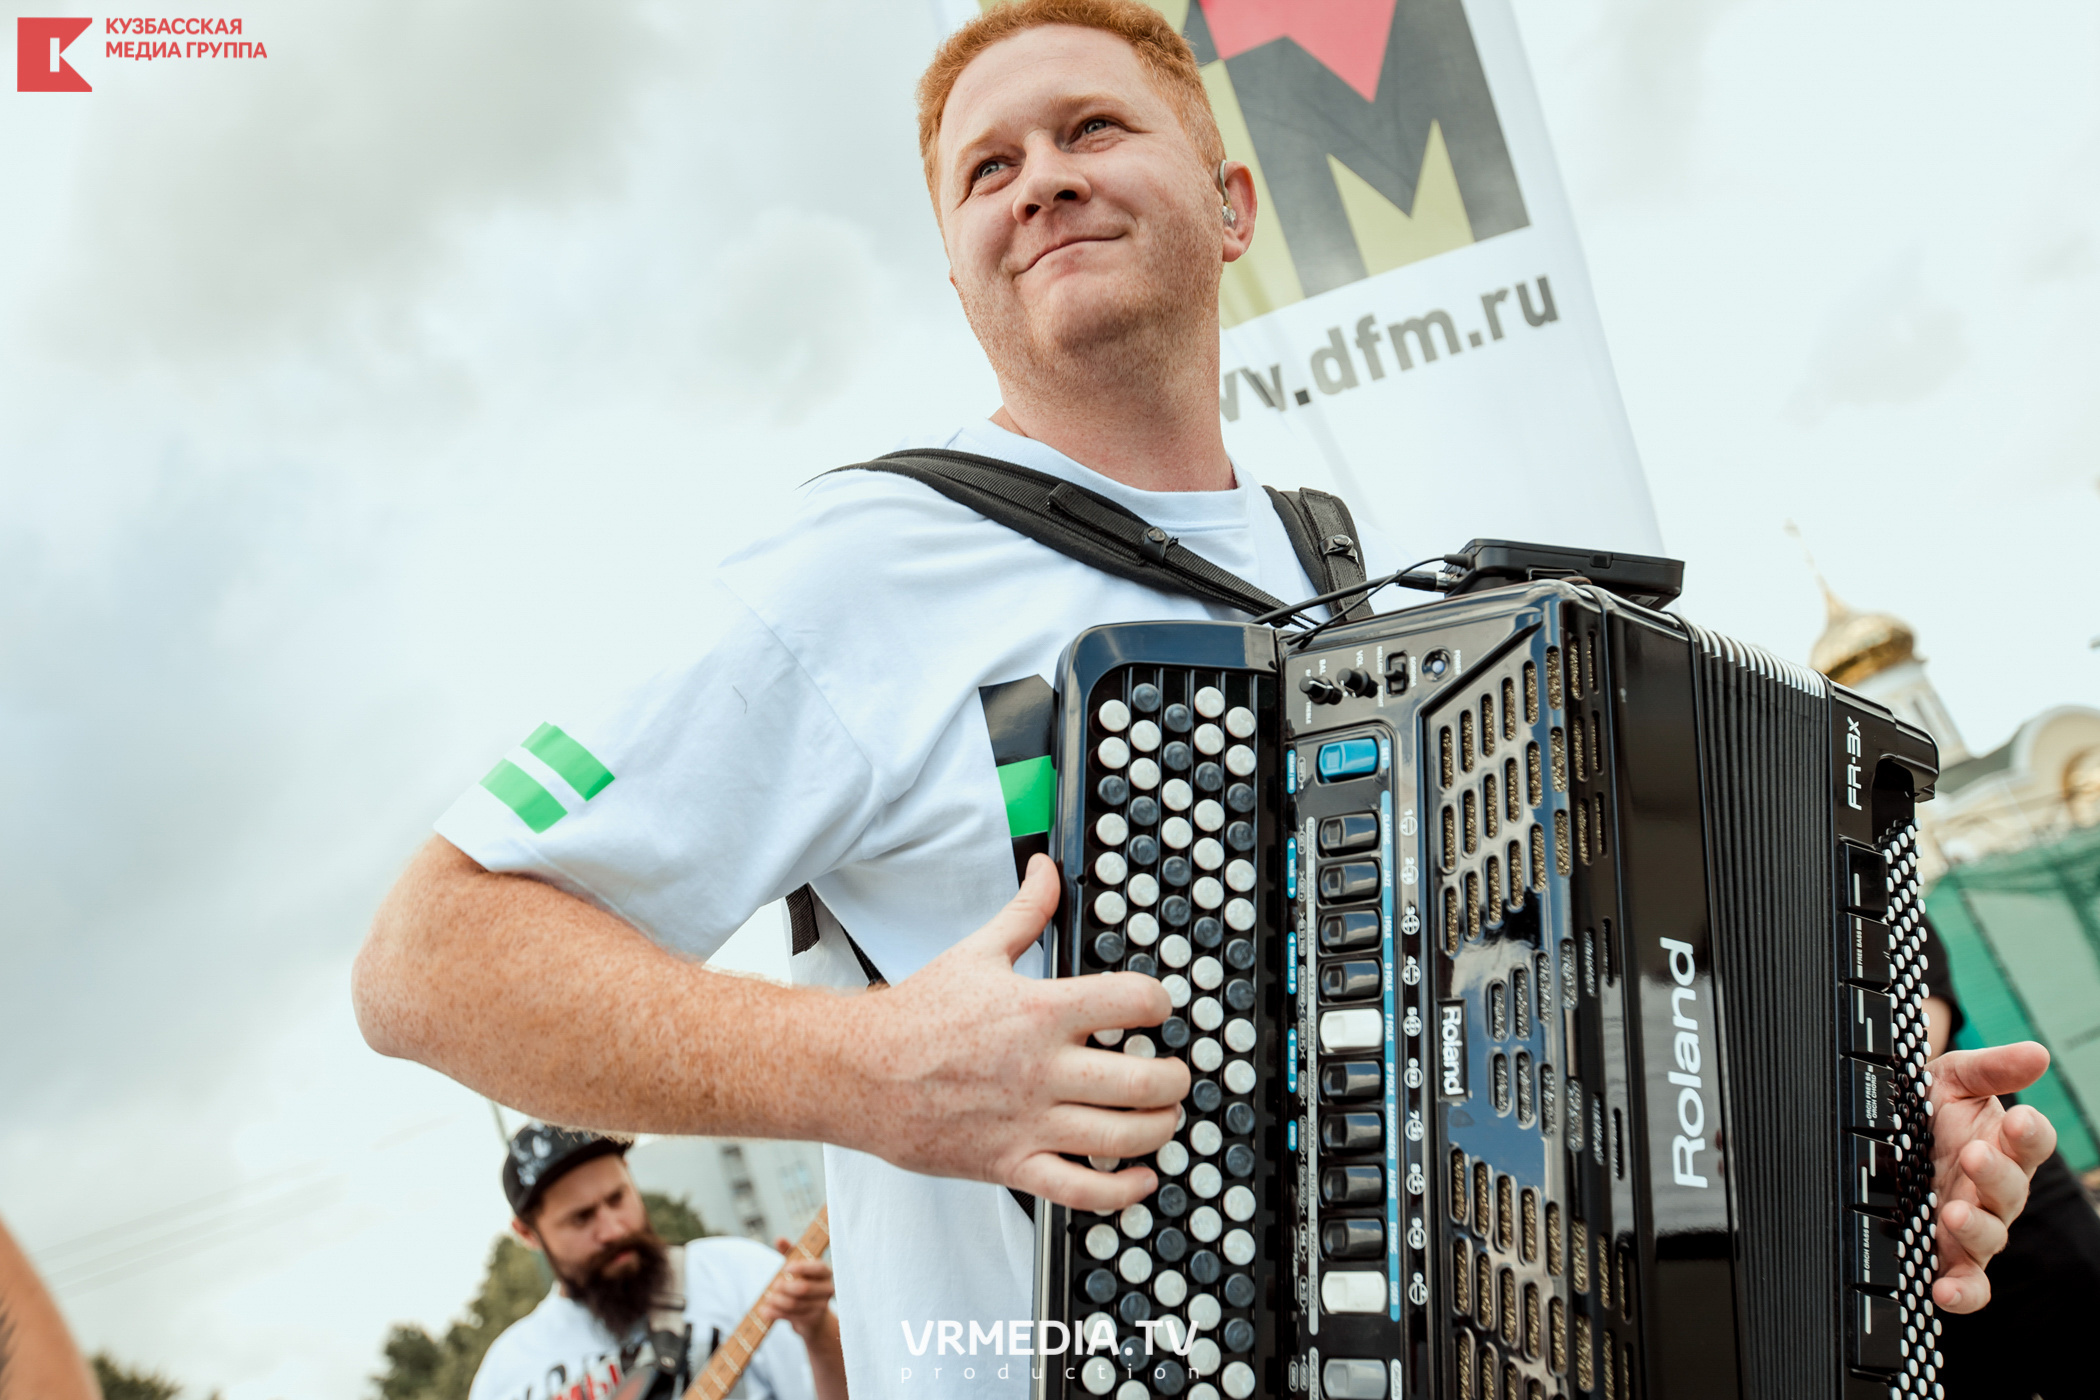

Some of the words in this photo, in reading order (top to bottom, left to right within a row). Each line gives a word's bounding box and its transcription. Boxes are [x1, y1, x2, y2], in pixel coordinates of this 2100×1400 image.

[1319, 658, 1327, 676] BAL
[1355, 649, 1364, 668] VOL
[1381, 746, 1389, 761] SET
[1403, 808, 1414, 816] 1
[1383, 813, 1391, 846] CLASSIC
[1404, 857, 1415, 865] 2
[1405, 906, 1416, 915] 3
[1406, 955, 1417, 965] 4
[1385, 971, 1393, 992] FOLK
[1407, 1006, 1418, 1016] 5
[1386, 1020, 1394, 1042] FOLK
[1442, 1006, 1465, 1096] Roland
[1408, 1058, 1419, 1068] 6
[1659, 936, 1708, 1188] Roland
[1386, 1074, 1394, 1096] FOLK
[1409, 1110, 1420, 1120] 7
[1387, 1102, 1396, 1160] BANDONEON
[1410, 1163, 1421, 1174] 8
[1388, 1168, 1397, 1200] ALPINE
[1411, 1217, 1422, 1228] 9
[1389, 1221, 1398, 1256] ETHNIC
[1391, 1281, 1399, 1306] USER
